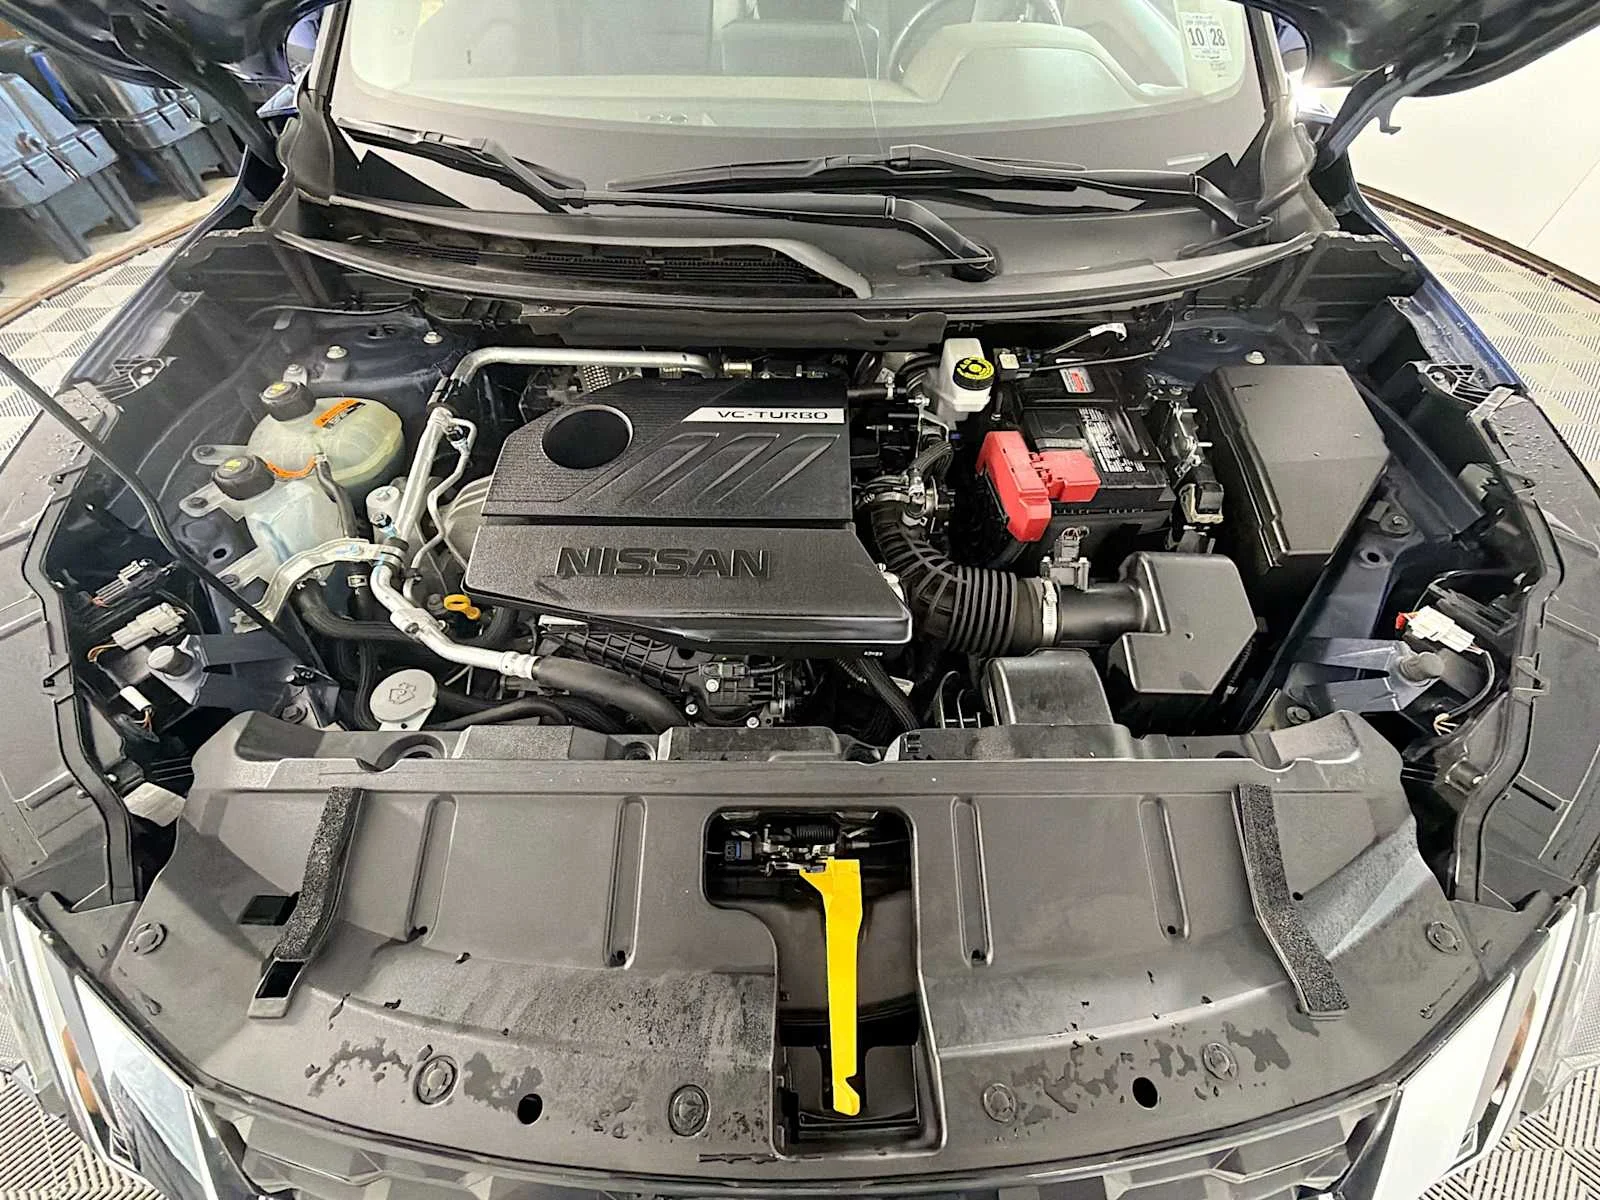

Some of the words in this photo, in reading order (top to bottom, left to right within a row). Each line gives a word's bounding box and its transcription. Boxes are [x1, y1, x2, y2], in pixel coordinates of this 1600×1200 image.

[1187, 27, 1205, 46] 10
[1210, 27, 1225, 46] 28
[555, 547, 770, 579] NISSAN
